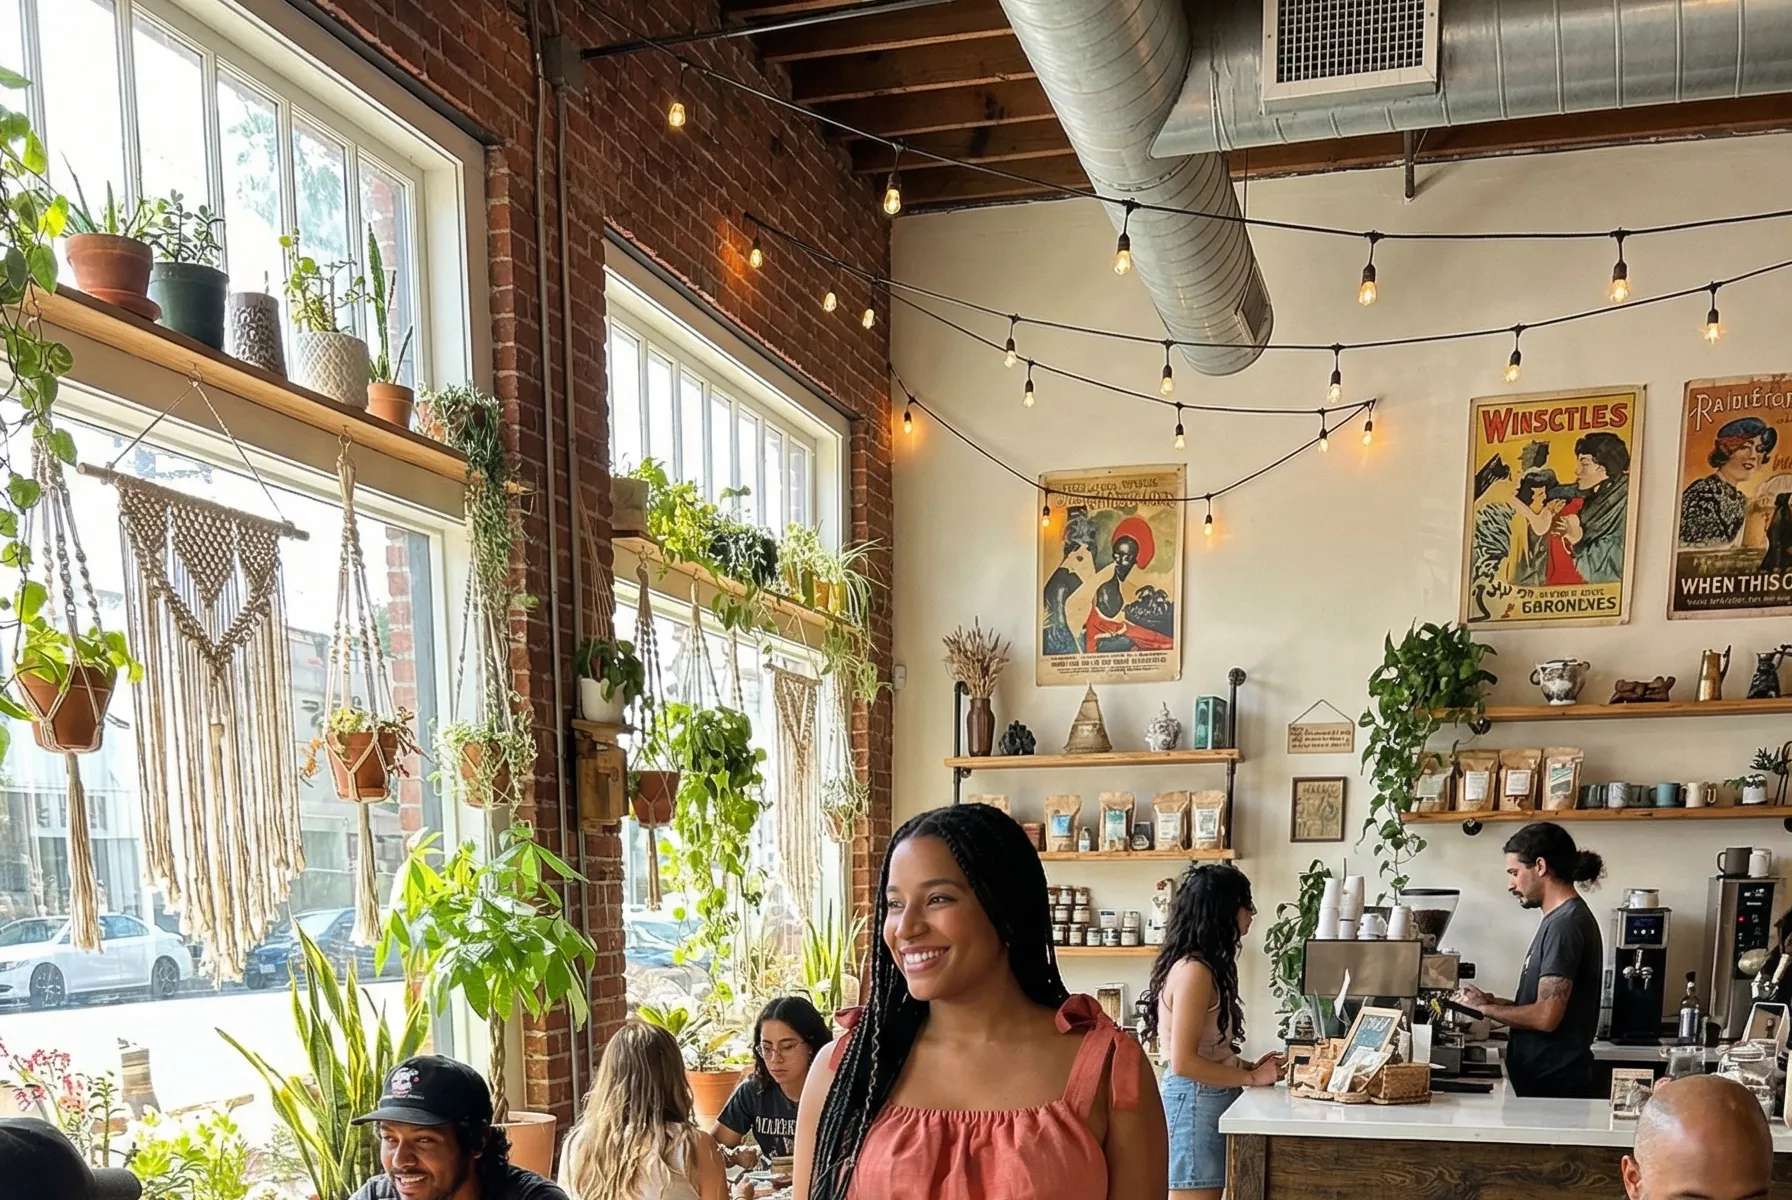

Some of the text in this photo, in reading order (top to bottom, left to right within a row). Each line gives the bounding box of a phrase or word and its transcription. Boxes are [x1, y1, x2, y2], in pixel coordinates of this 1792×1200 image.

[1482, 403, 1628, 444] WINSCTLES
[1681, 577, 1735, 595] WHEN
[1738, 574, 1780, 592] THIS
